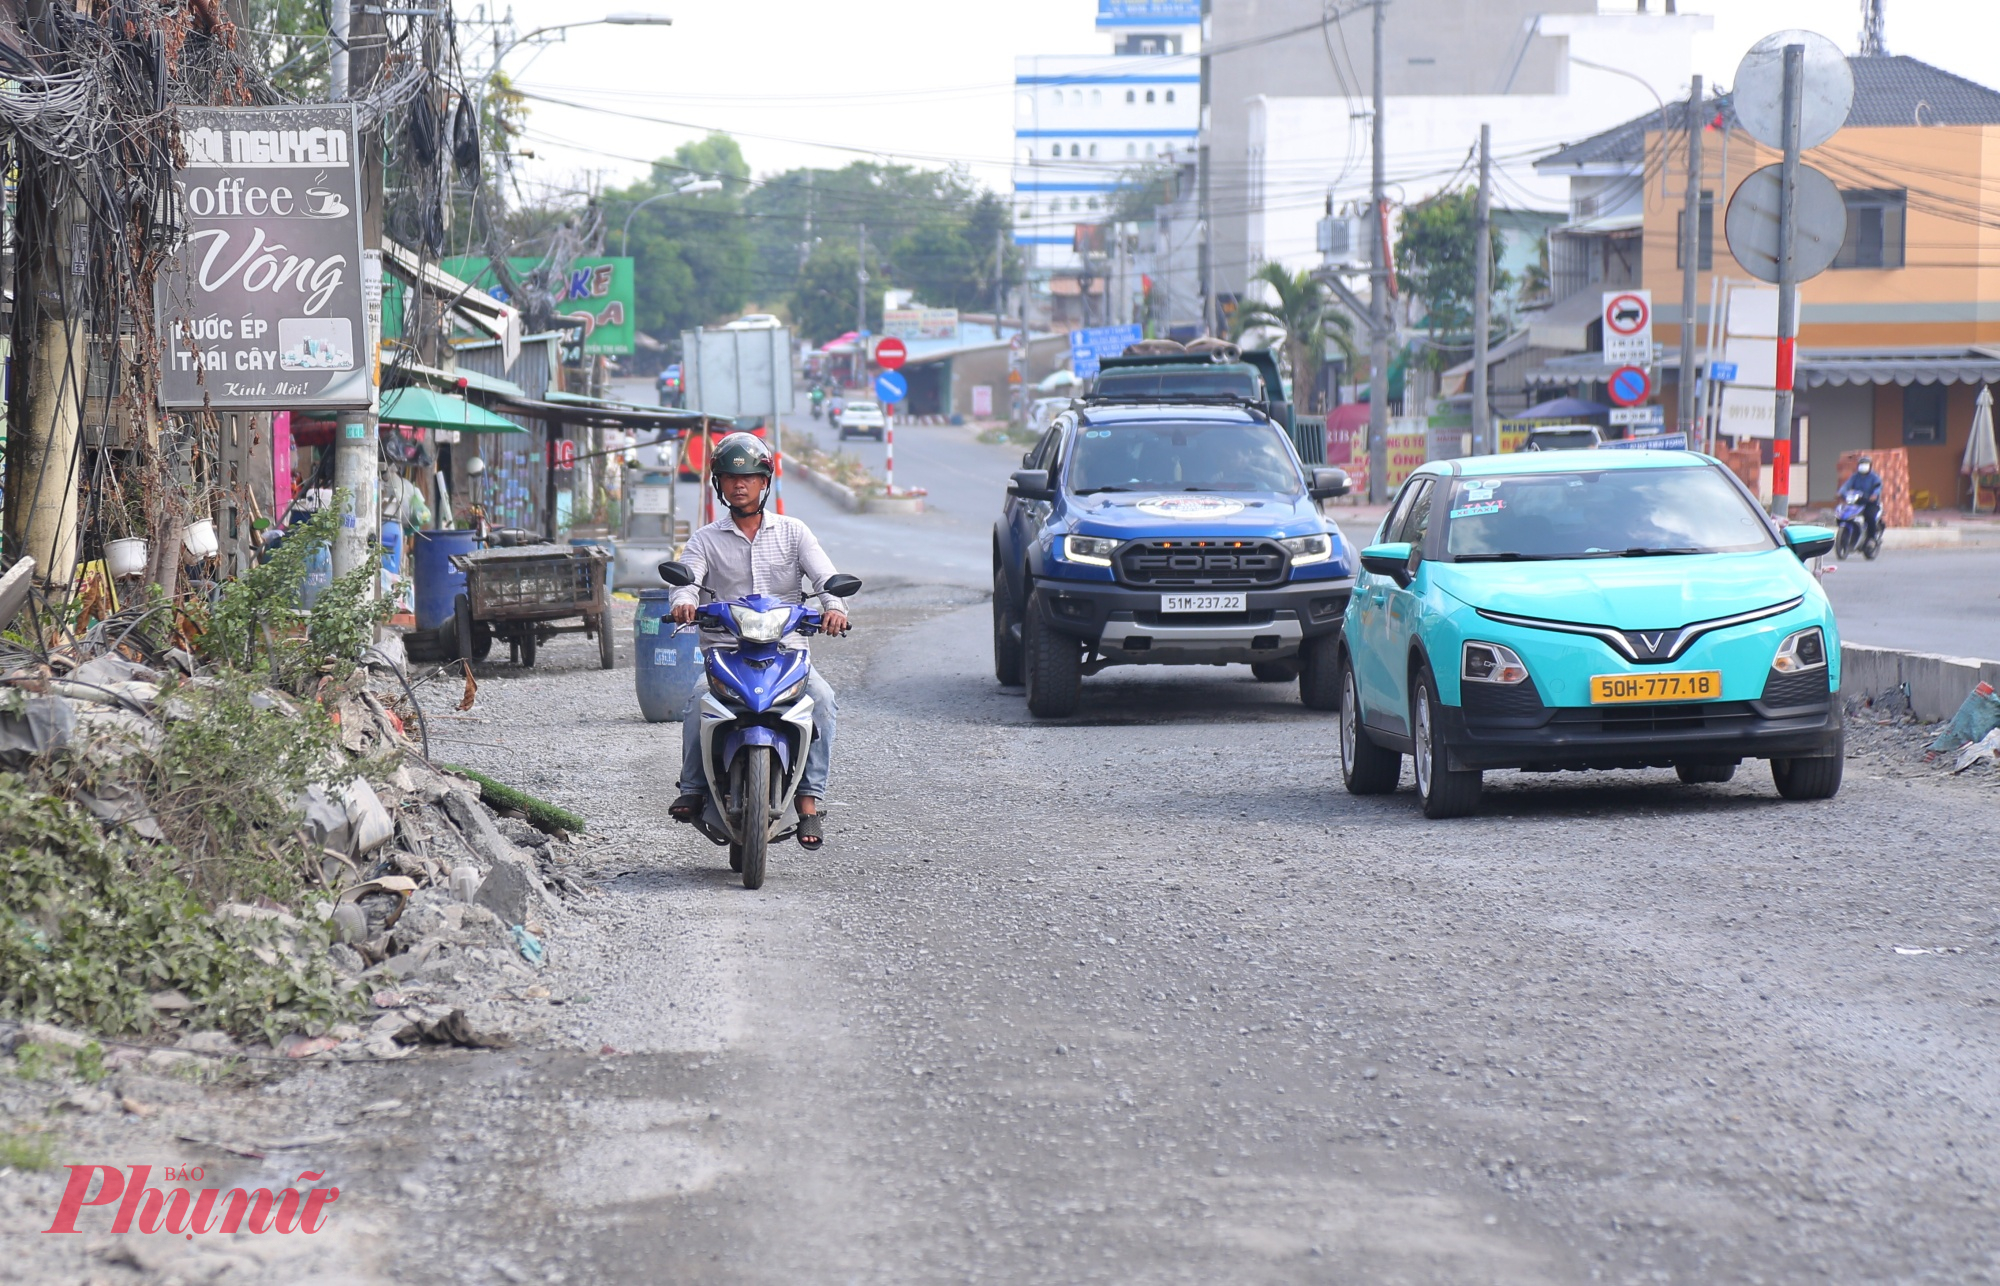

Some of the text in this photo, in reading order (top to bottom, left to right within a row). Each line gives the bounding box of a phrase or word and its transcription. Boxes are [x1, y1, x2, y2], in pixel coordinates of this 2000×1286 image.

[229, 126, 348, 163] NGUYÊN
[177, 313, 268, 340] NƯỚC ÉP
[177, 344, 278, 372] TRÁI CÂY
[220, 381, 310, 397] Kính Mời!
[1472, 506, 1494, 514] TAXI
[1130, 554, 1275, 570] FORD
[1168, 596, 1240, 610] 51M-237.22
[1602, 676, 1710, 698] 50H-777.18
